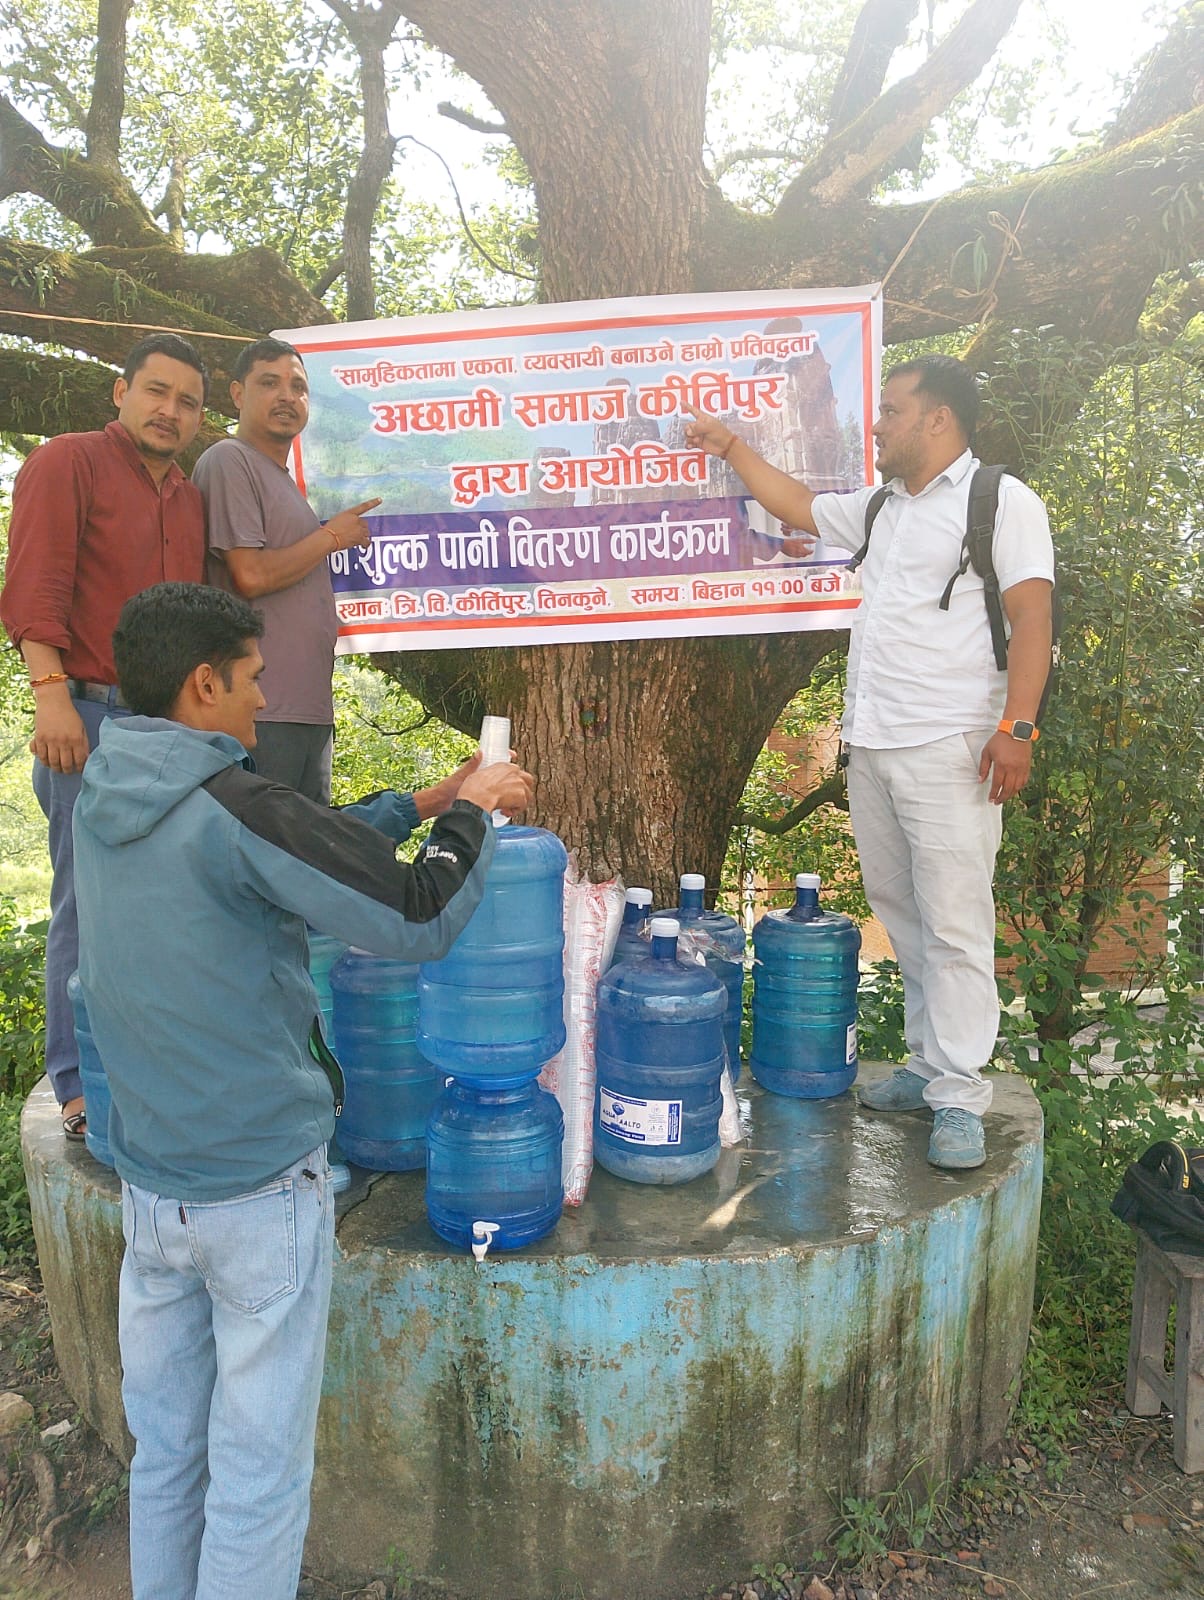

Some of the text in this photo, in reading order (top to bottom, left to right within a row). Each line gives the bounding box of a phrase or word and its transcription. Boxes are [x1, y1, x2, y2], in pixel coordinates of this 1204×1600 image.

[524, 345, 605, 370] व्यवसायी
[610, 340, 675, 365] बनाउने
[681, 336, 724, 361] हाम्रो
[373, 371, 786, 432] अछामी समाज कीर्तिपुर
[452, 443, 707, 504] द्वारा आयोजित
[437, 518, 499, 570] पानी
[508, 516, 601, 568] वितरण
[609, 510, 732, 563] कार्यक्रम
[394, 594, 420, 616] त्रि.
[427, 593, 449, 613] वि.
[692, 580, 745, 601] बिहान
[811, 572, 841, 592] बजे
[619, 1119, 641, 1129] AALTO
